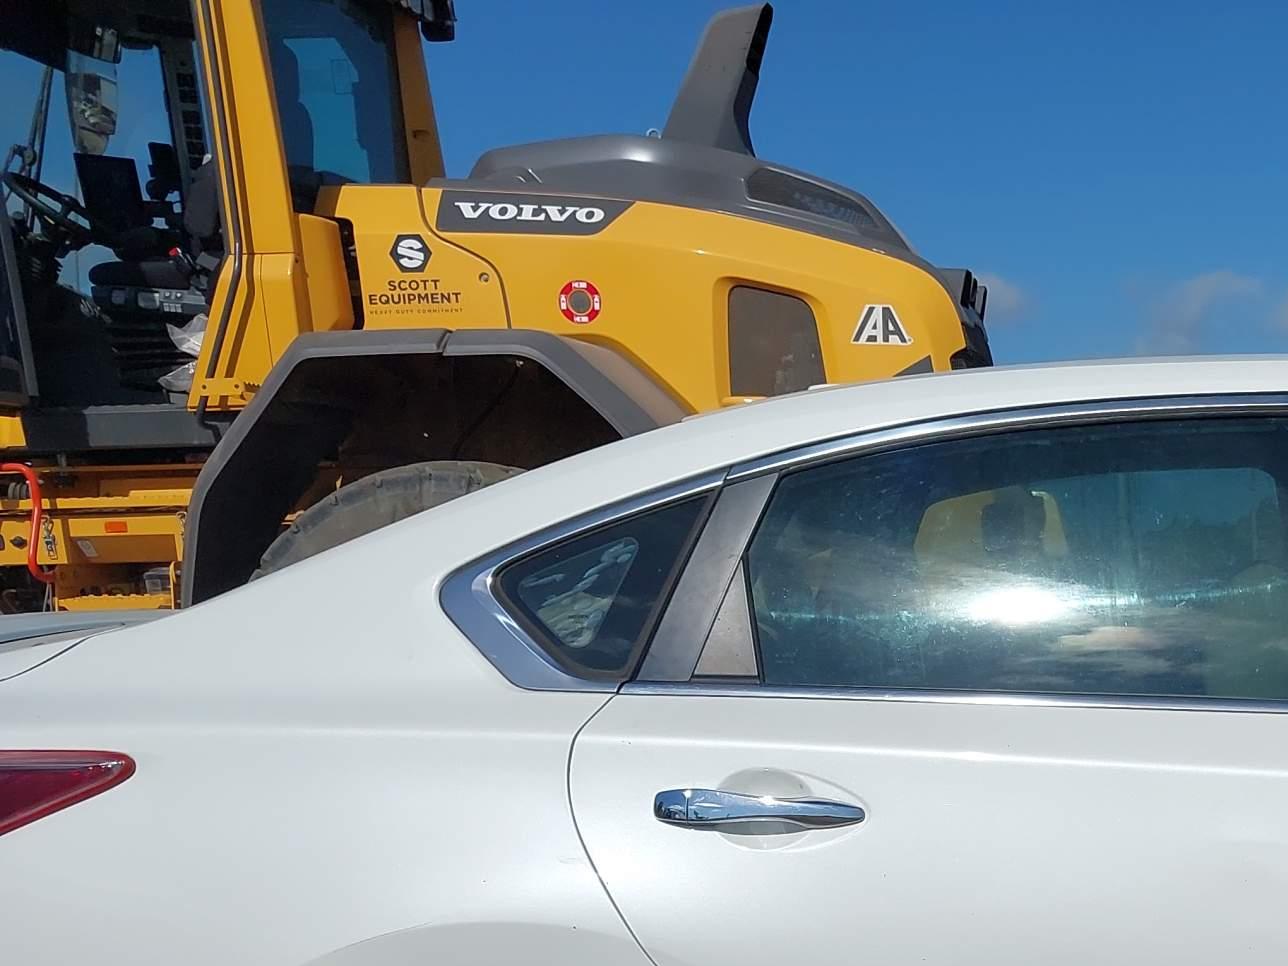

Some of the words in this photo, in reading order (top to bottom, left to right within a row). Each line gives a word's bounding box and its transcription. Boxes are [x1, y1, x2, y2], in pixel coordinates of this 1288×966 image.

[454, 202, 605, 224] VOLVO
[387, 279, 440, 292] SCOTT
[368, 292, 462, 305] EQUIPMENT
